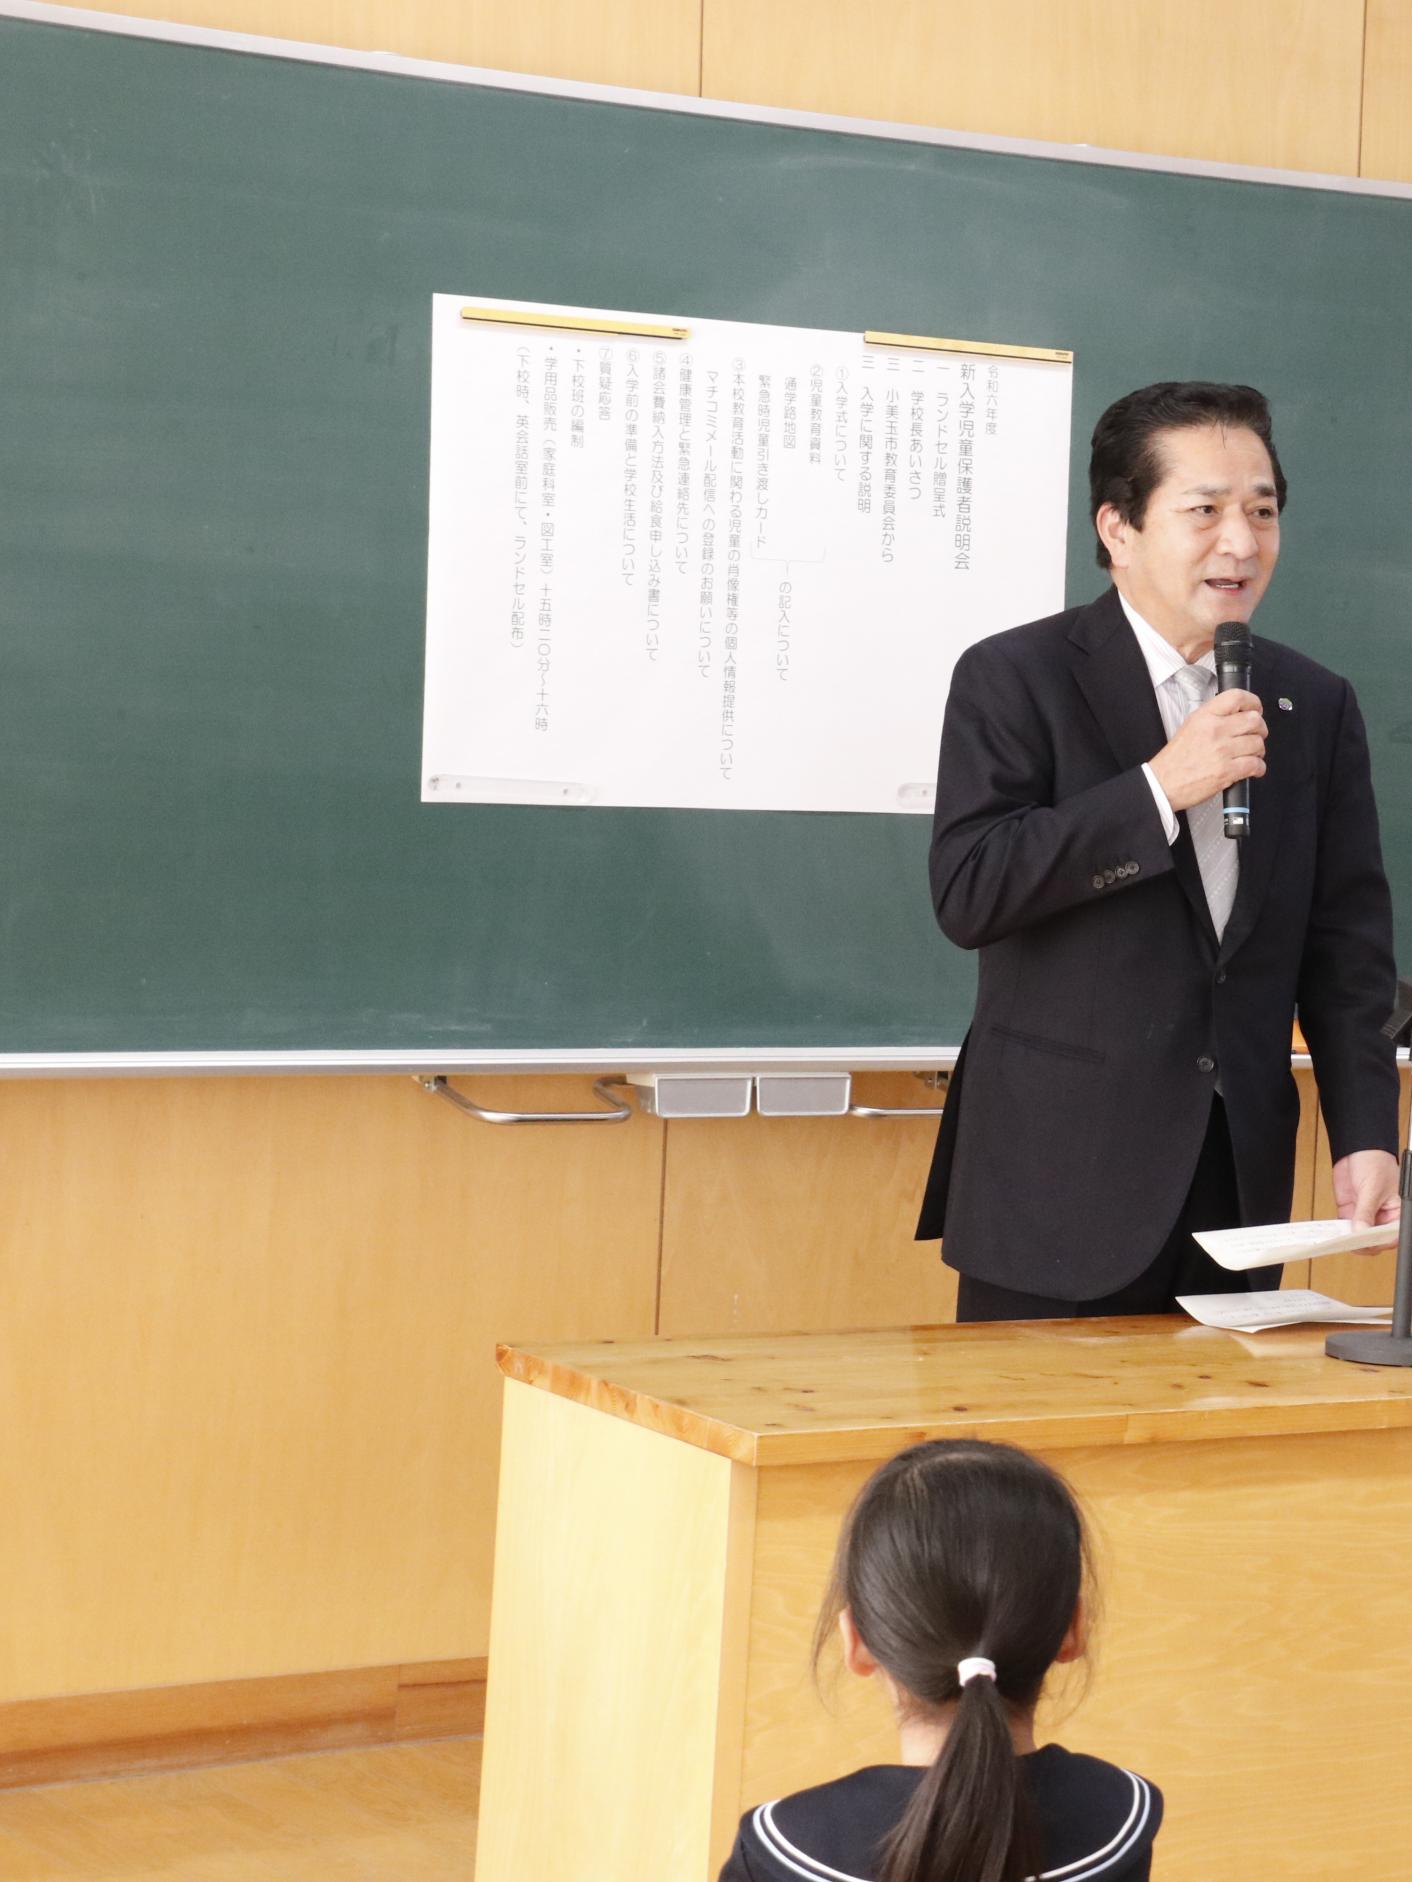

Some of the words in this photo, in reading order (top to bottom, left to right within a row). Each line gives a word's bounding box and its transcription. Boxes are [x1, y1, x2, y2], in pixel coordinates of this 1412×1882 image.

[858, 386, 874, 514] 入学に関する説明
[909, 390, 925, 500] 学校長あいさつ
[933, 392, 949, 518] ランドセル贈呈式
[985, 364, 1000, 436] 令和六年度
[881, 387, 899, 563] 小美玉市教育委員会から
[954, 363, 976, 571] 新入学児童保護者説明会
